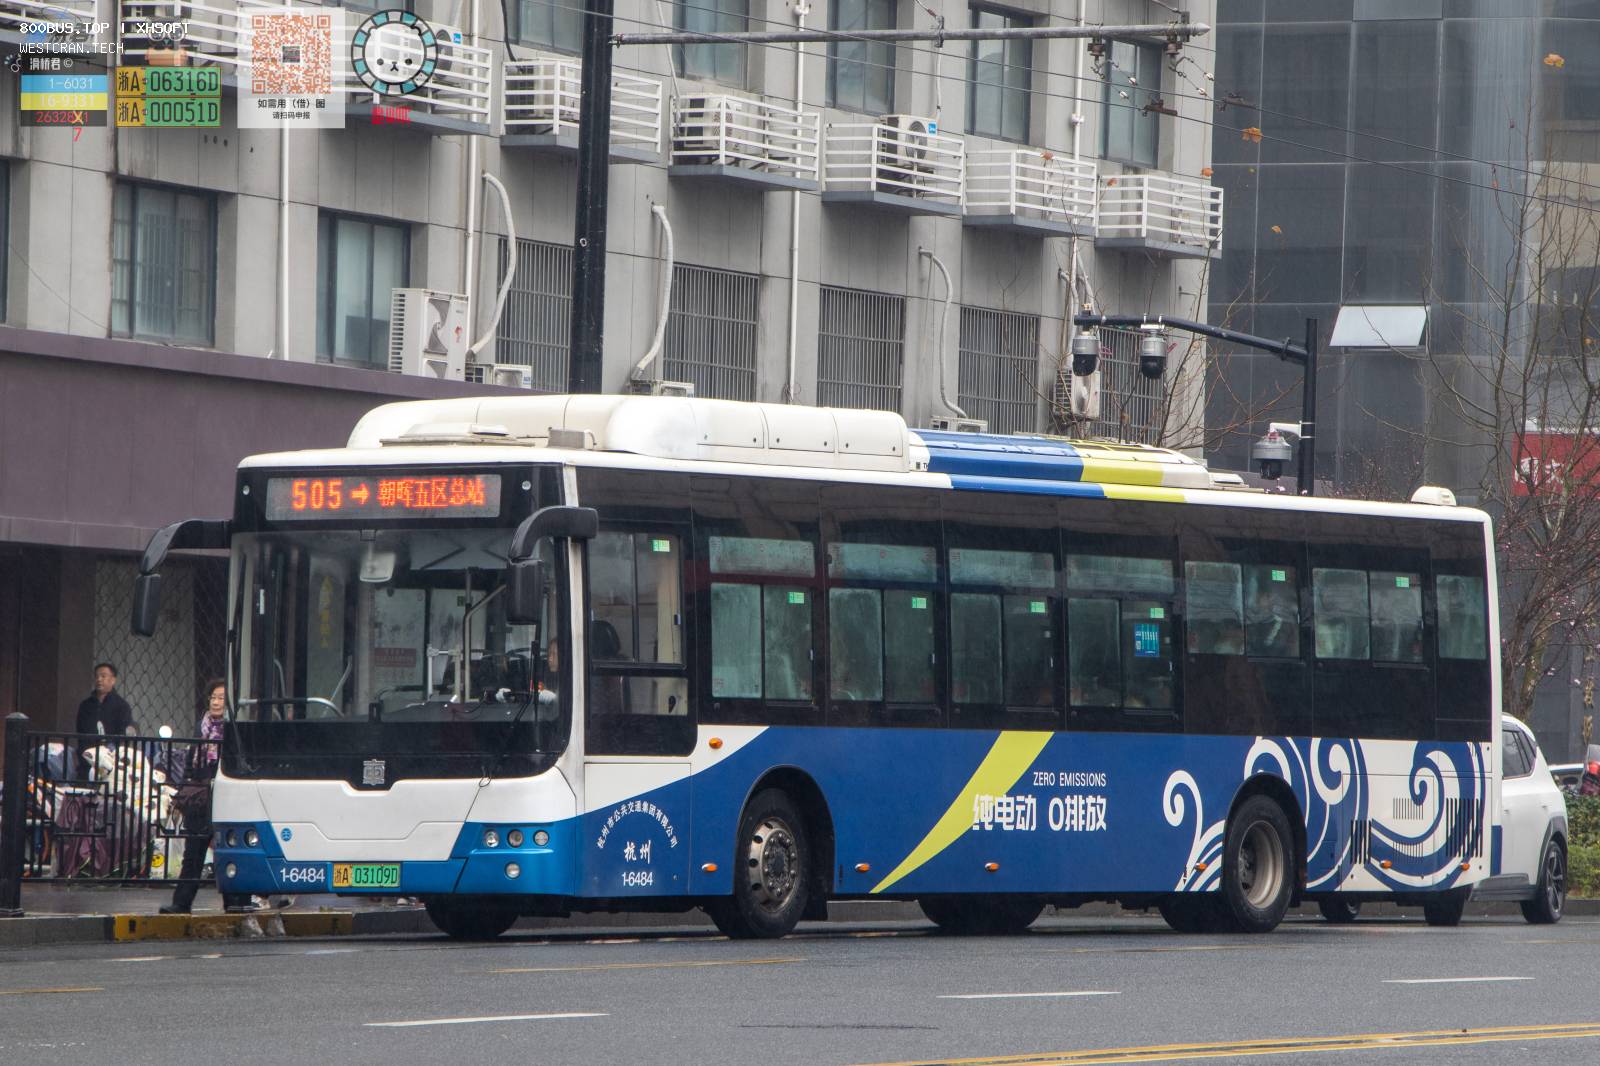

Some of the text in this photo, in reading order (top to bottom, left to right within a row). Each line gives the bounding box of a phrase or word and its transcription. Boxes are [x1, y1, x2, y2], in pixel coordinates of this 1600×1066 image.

[292, 477, 485, 510] 505 朝晖五区总站
[1033, 771, 1107, 787] ZERO EMISSIONS
[972, 794, 1037, 831] 纯电动
[624, 840, 651, 864] 杭州
